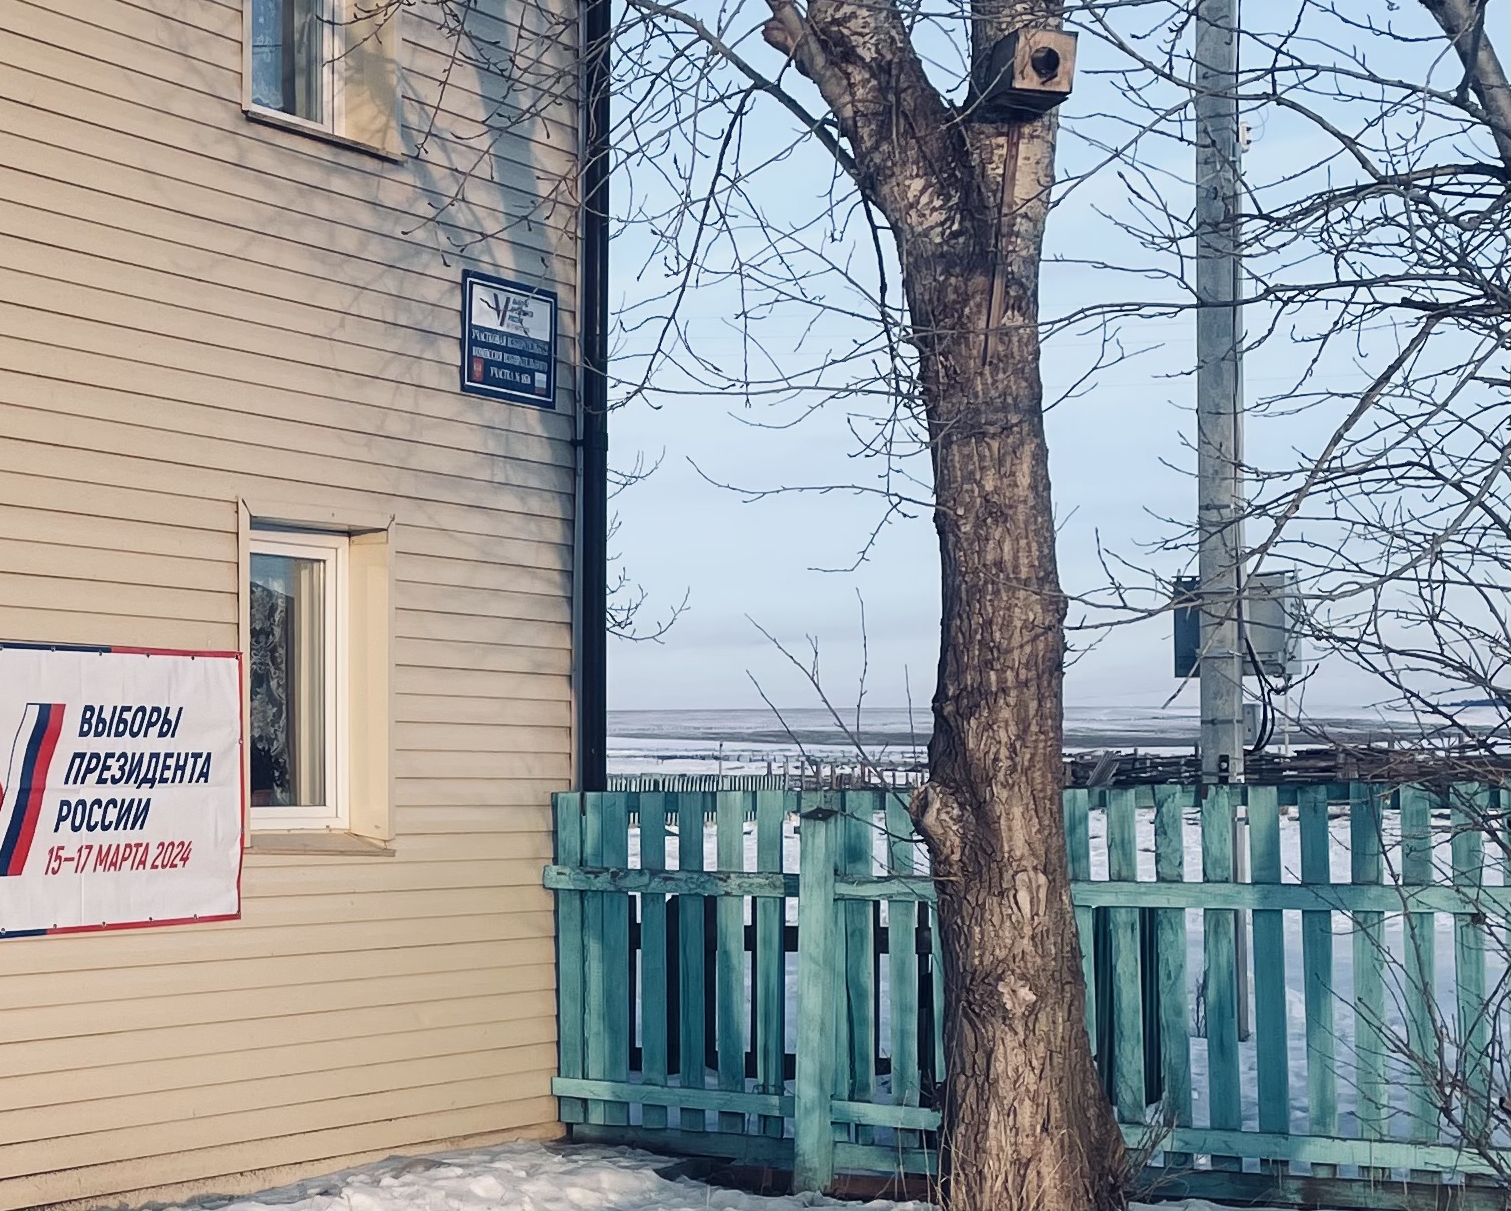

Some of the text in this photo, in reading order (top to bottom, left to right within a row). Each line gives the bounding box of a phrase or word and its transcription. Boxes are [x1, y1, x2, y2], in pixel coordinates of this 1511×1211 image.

[77, 704, 184, 739] ВЫБОРЫ
[63, 751, 212, 790] ПРЕЗИДЕНТА
[53, 797, 152, 834] РОССИИ
[93, 841, 149, 873] МАРТА
[149, 840, 193, 871] 2024
